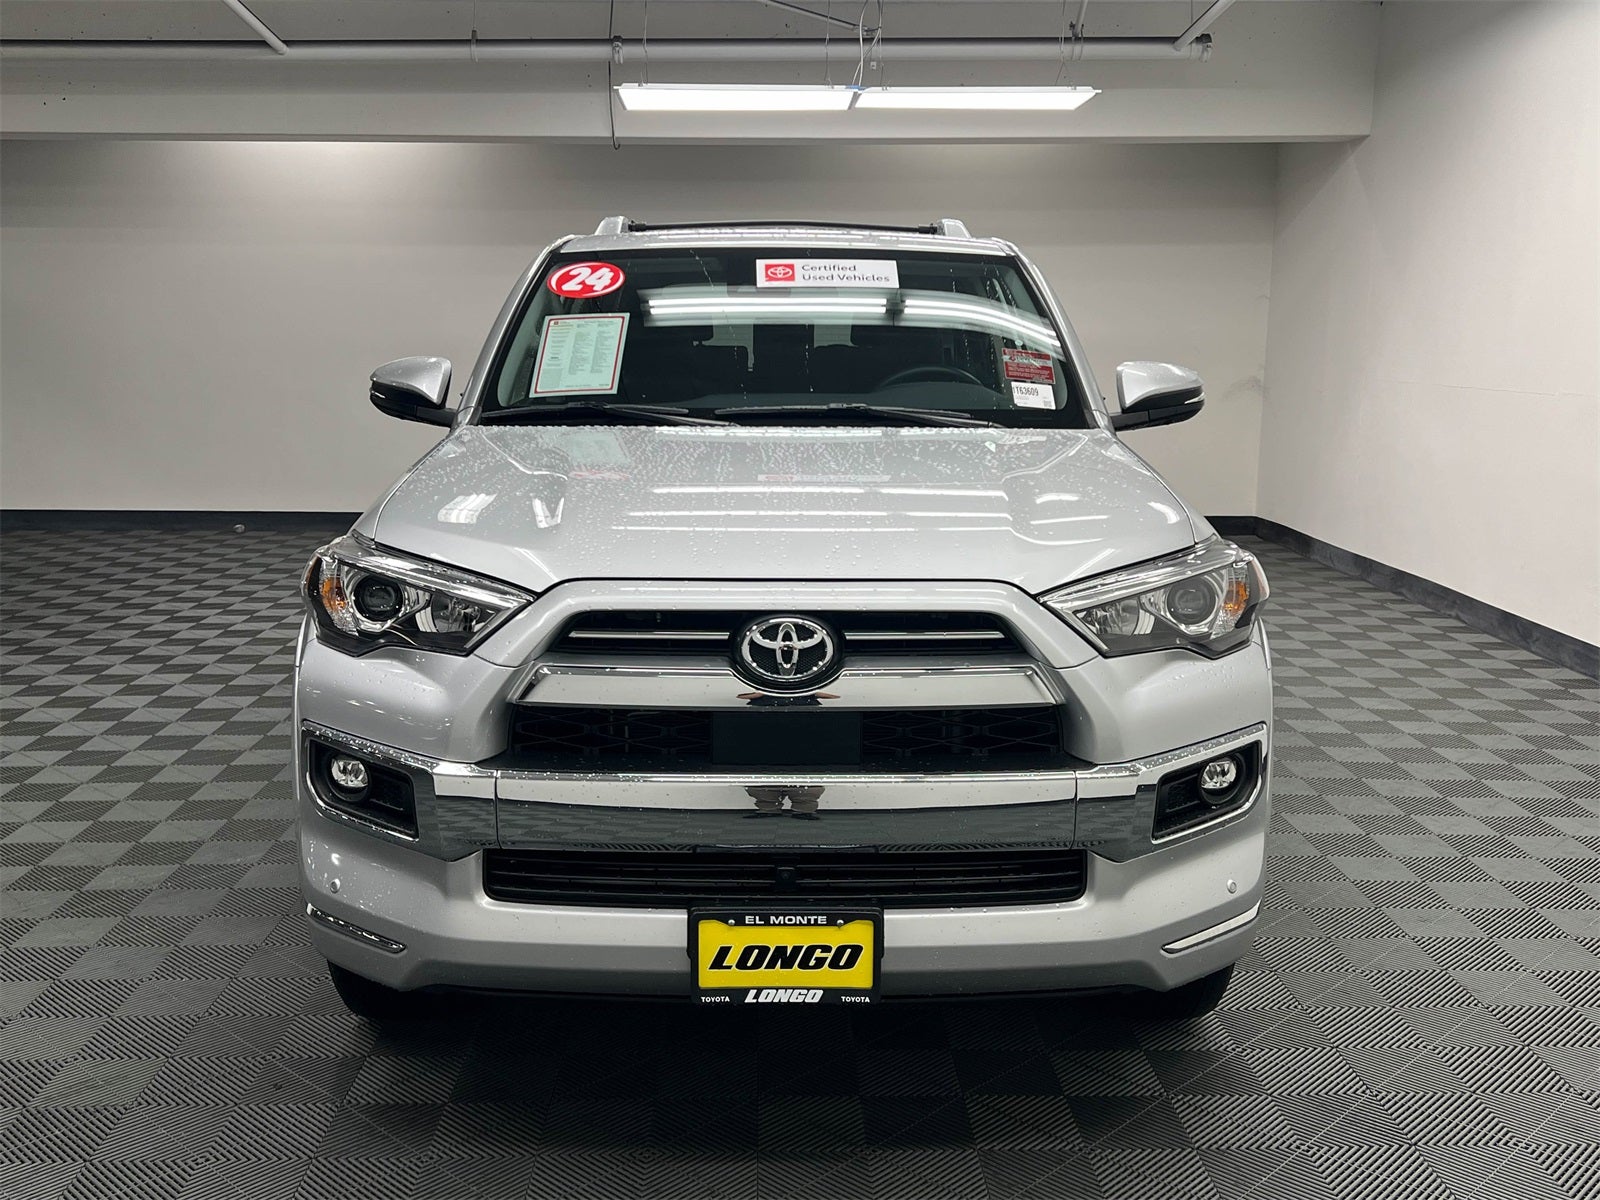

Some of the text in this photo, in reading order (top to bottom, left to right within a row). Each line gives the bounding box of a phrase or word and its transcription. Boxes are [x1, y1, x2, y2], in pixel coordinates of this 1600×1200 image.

[801, 264, 857, 272] Certified
[561, 267, 614, 291] 24
[802, 273, 890, 282] Used Vehicles
[745, 915, 827, 925] EL MONTE
[707, 943, 864, 972] LONGO
[744, 989, 824, 1003] LONGO
